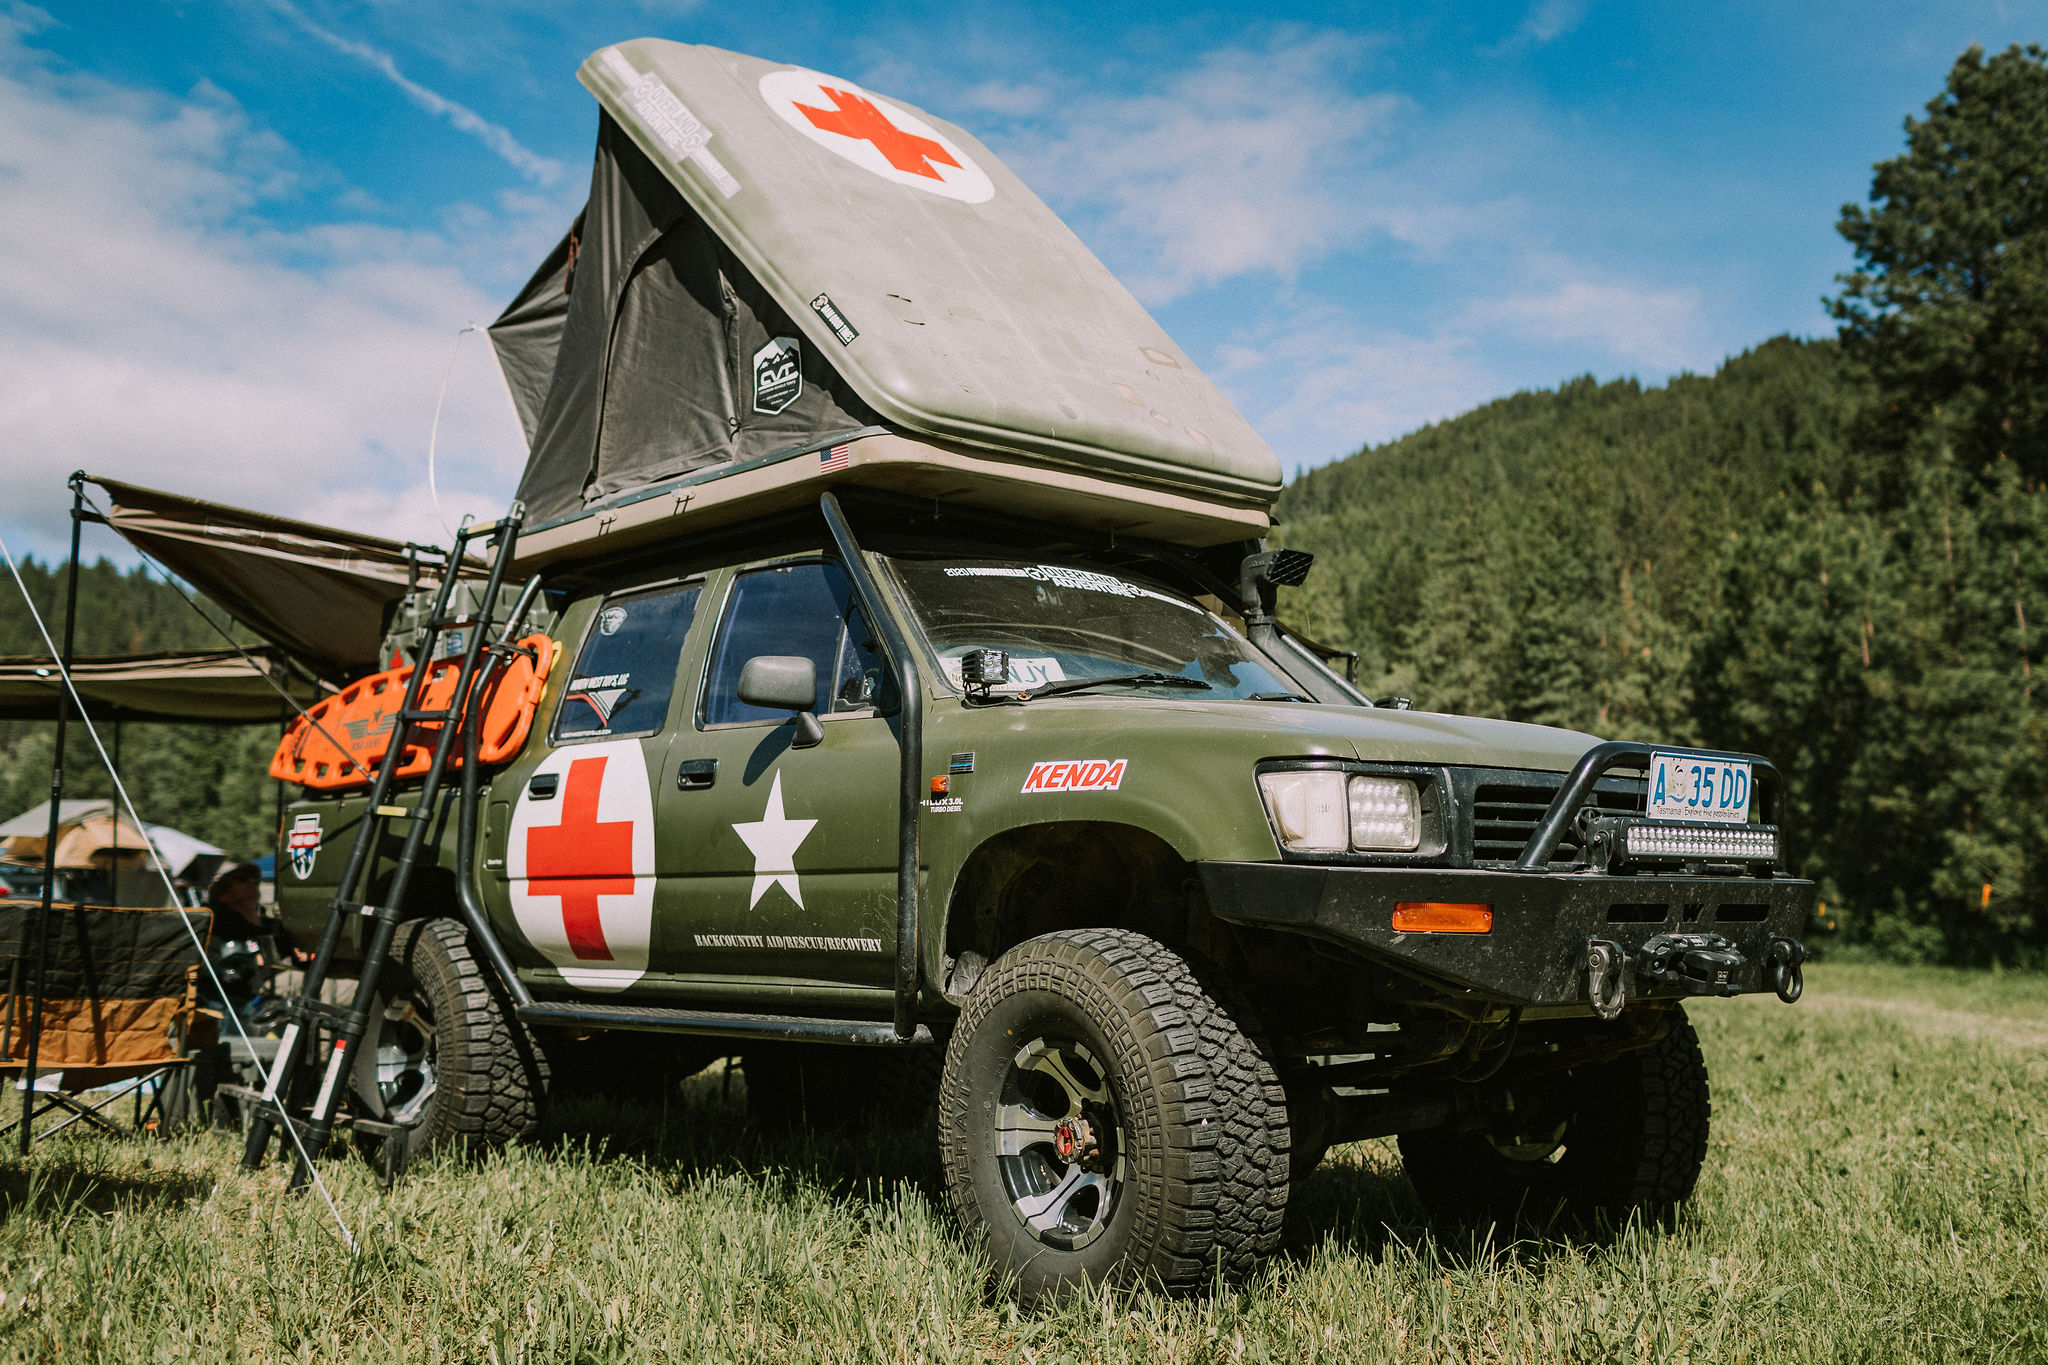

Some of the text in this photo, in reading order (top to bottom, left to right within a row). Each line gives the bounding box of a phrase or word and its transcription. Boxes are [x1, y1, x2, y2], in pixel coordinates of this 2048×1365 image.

[650, 87, 698, 134] OVERLAND
[633, 99, 684, 150] ADVENTURE
[944, 568, 968, 577] 2020
[1044, 567, 1124, 588] OVERLAND
[1052, 577, 1136, 598] ADVENTURE
[1024, 762, 1125, 790] KENDA
[1653, 762, 1748, 809] A 35 DD
[930, 805, 946, 813] TURBO
[1656, 805, 1740, 819] Tasmania Explore the possibilities
[694, 934, 883, 952] BACKCOUNTRY AID/RESCUE/RECOVERY
